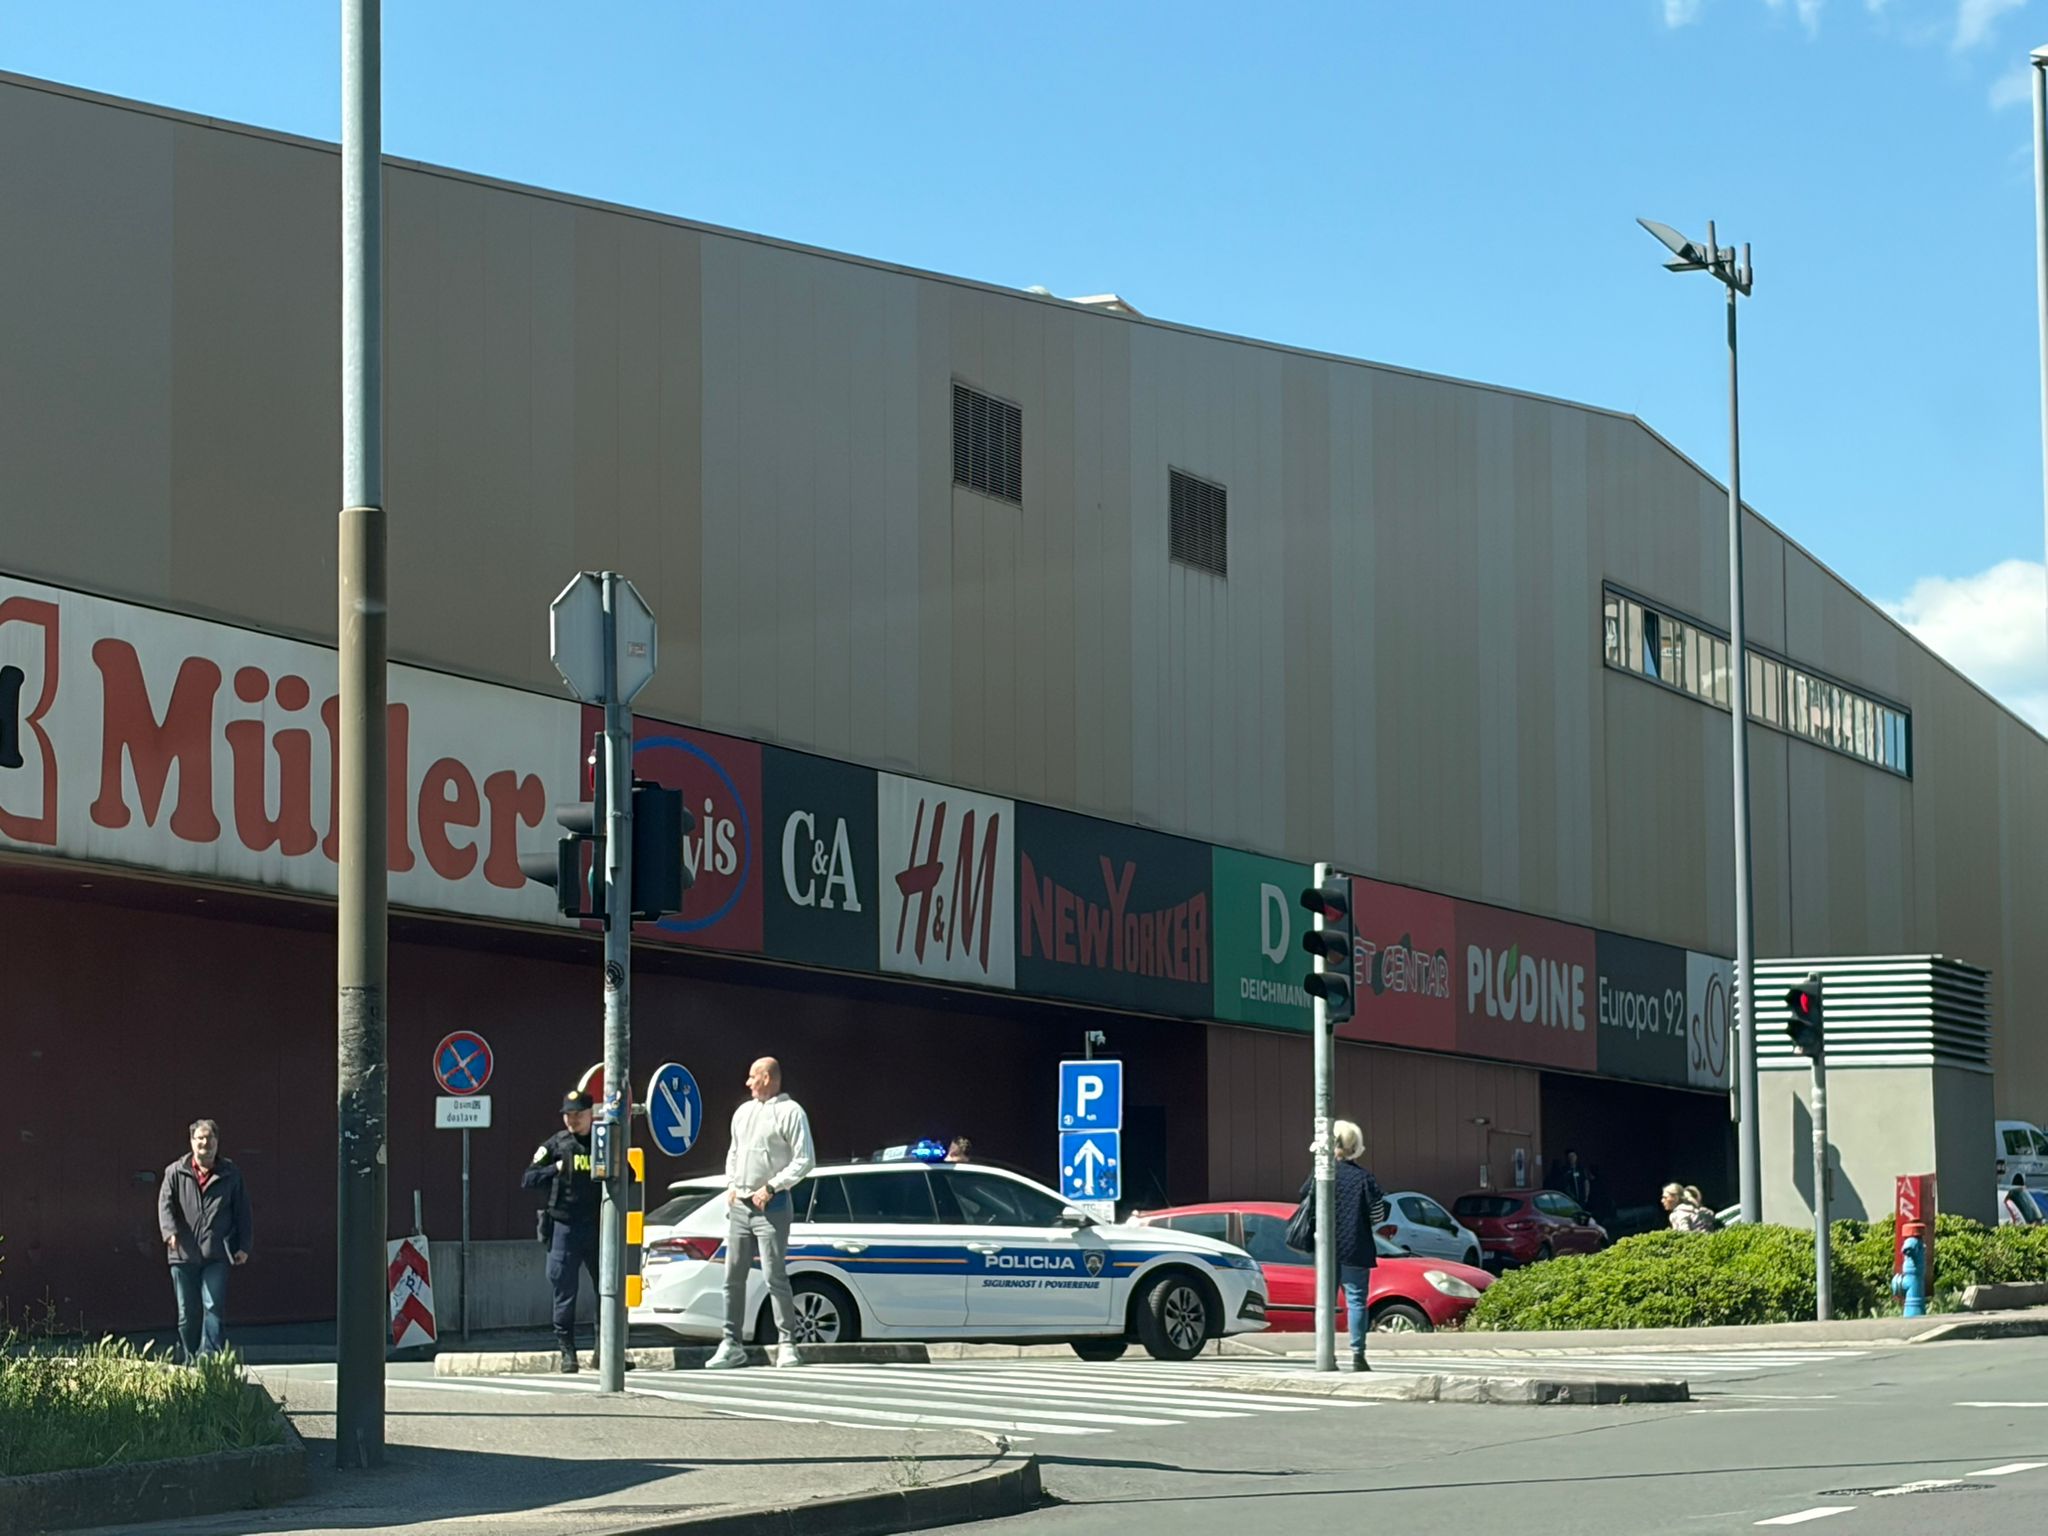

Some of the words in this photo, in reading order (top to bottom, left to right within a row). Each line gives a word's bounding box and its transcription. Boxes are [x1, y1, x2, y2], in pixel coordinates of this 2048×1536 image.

[782, 810, 862, 912] C&A
[895, 798, 1000, 974] H&M
[1261, 883, 1290, 964] D
[1354, 936, 1376, 985] ET
[1381, 945, 1450, 999] CENTAR
[1467, 944, 1586, 1031] PLODINE
[1599, 976, 1659, 1040] Europa
[1664, 988, 1685, 1036] 92
[1077, 1075, 1104, 1118] P
[982, 1279, 1037, 1288] SIGURNOST
[985, 1255, 1075, 1270] POLICIJA
